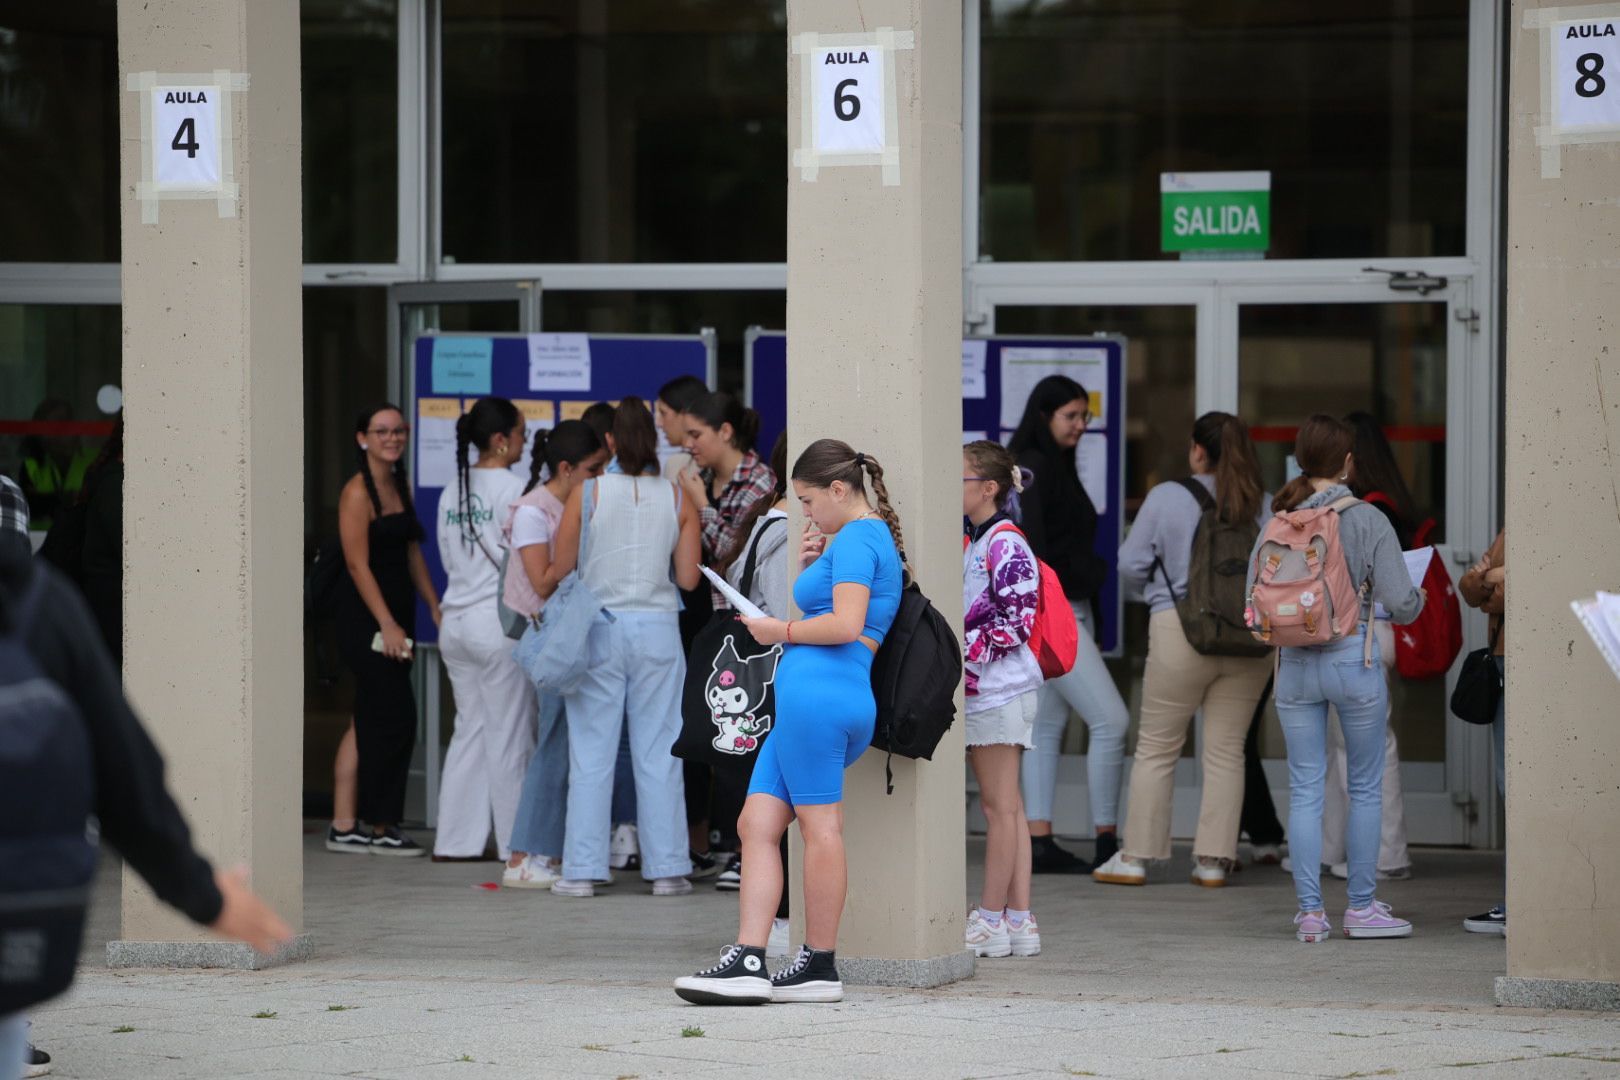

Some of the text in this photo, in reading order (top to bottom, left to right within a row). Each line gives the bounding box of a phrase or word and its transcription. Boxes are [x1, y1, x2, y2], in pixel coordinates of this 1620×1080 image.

[1566, 23, 1616, 39] AULA
[825, 51, 869, 65] AULA
[1575, 52, 1606, 98] 8
[165, 91, 207, 104] AULA
[833, 78, 861, 121] 6
[171, 117, 199, 158] 4
[1173, 205, 1261, 236] SALIDA
